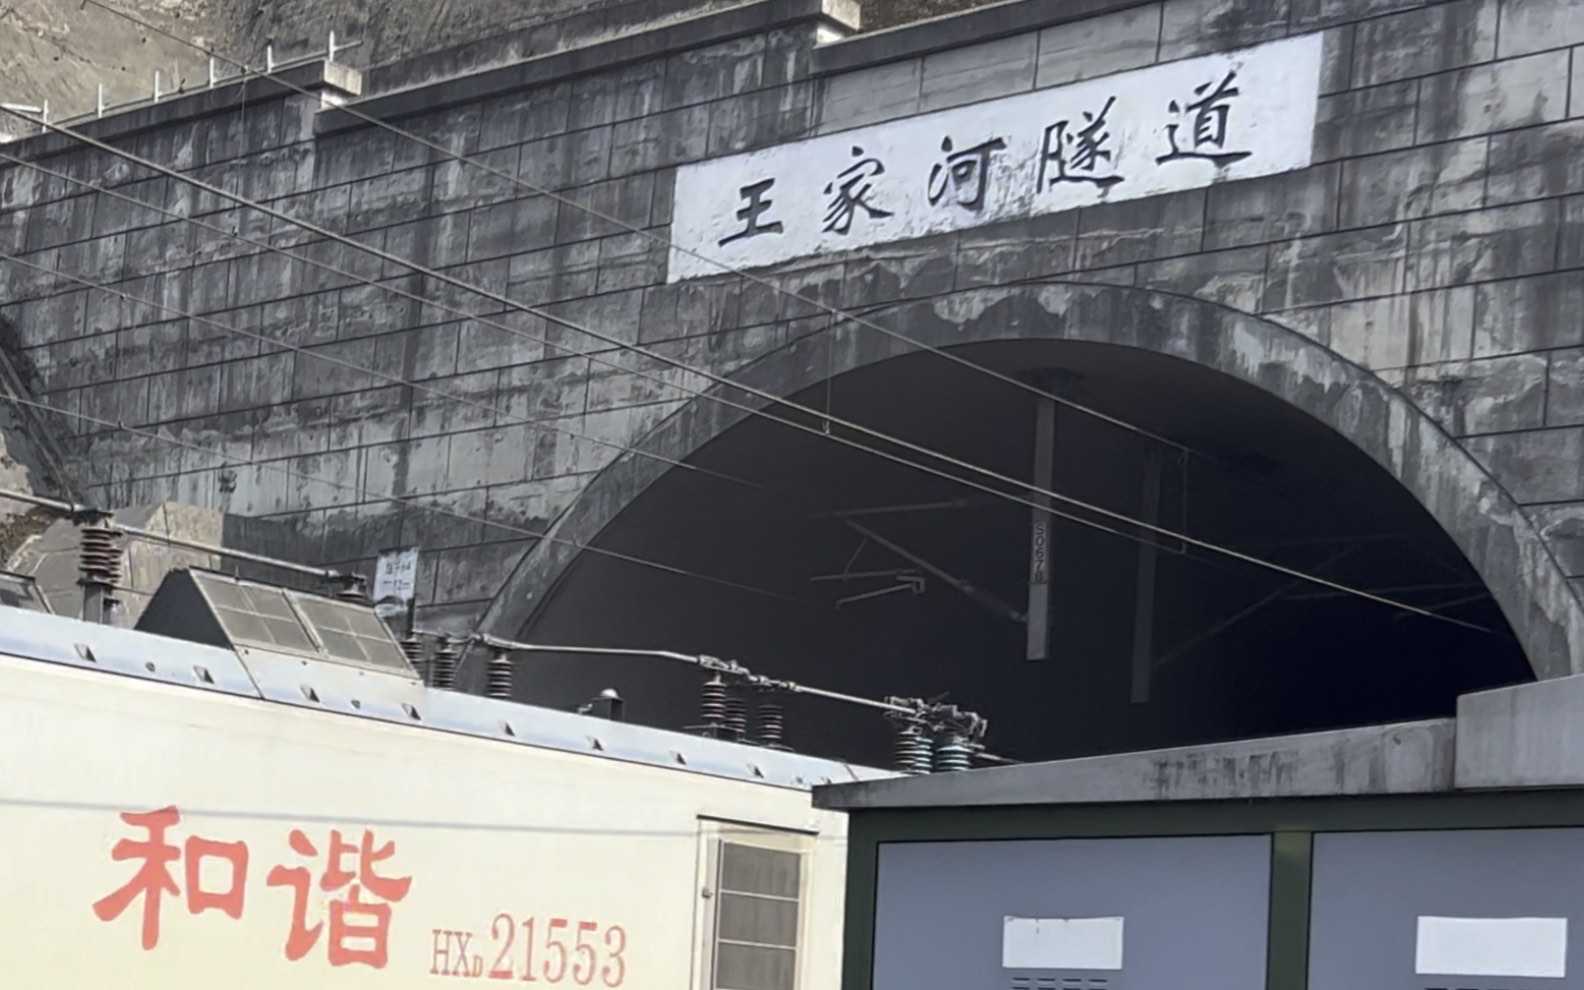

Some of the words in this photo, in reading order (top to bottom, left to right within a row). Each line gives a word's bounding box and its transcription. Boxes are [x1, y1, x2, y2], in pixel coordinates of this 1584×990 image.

[718, 72, 1252, 248] 王家河隧道
[92, 804, 413, 969] 和谐
